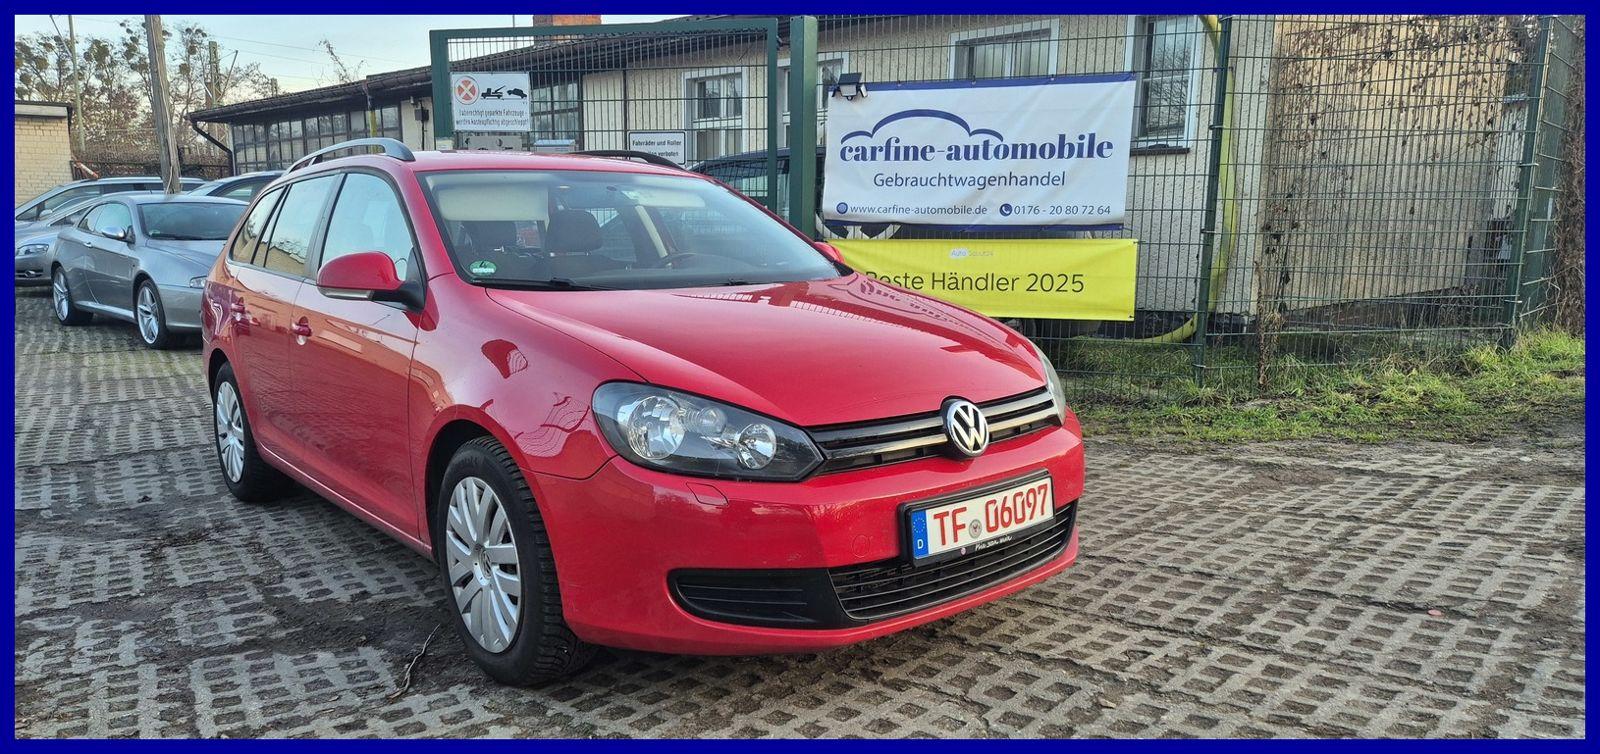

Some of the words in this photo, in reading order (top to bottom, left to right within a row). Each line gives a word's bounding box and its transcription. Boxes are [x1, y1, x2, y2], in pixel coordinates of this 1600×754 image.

[840, 132, 1114, 162] carfine-automobile
[873, 171, 1066, 191] Gebrauchtwagenhandel
[850, 204, 987, 215] www.carfine-automobile.de
[1014, 205, 1040, 215] 0176
[1049, 205, 1063, 215] 20
[1065, 205, 1079, 215] 80
[1082, 205, 1095, 215] 72
[1097, 205, 1111, 215] 64
[931, 271, 1020, 292] Händler
[1026, 273, 1085, 293] 2025
[933, 506, 968, 546] TF
[984, 483, 1049, 533] 06097
[917, 539, 924, 549] D
